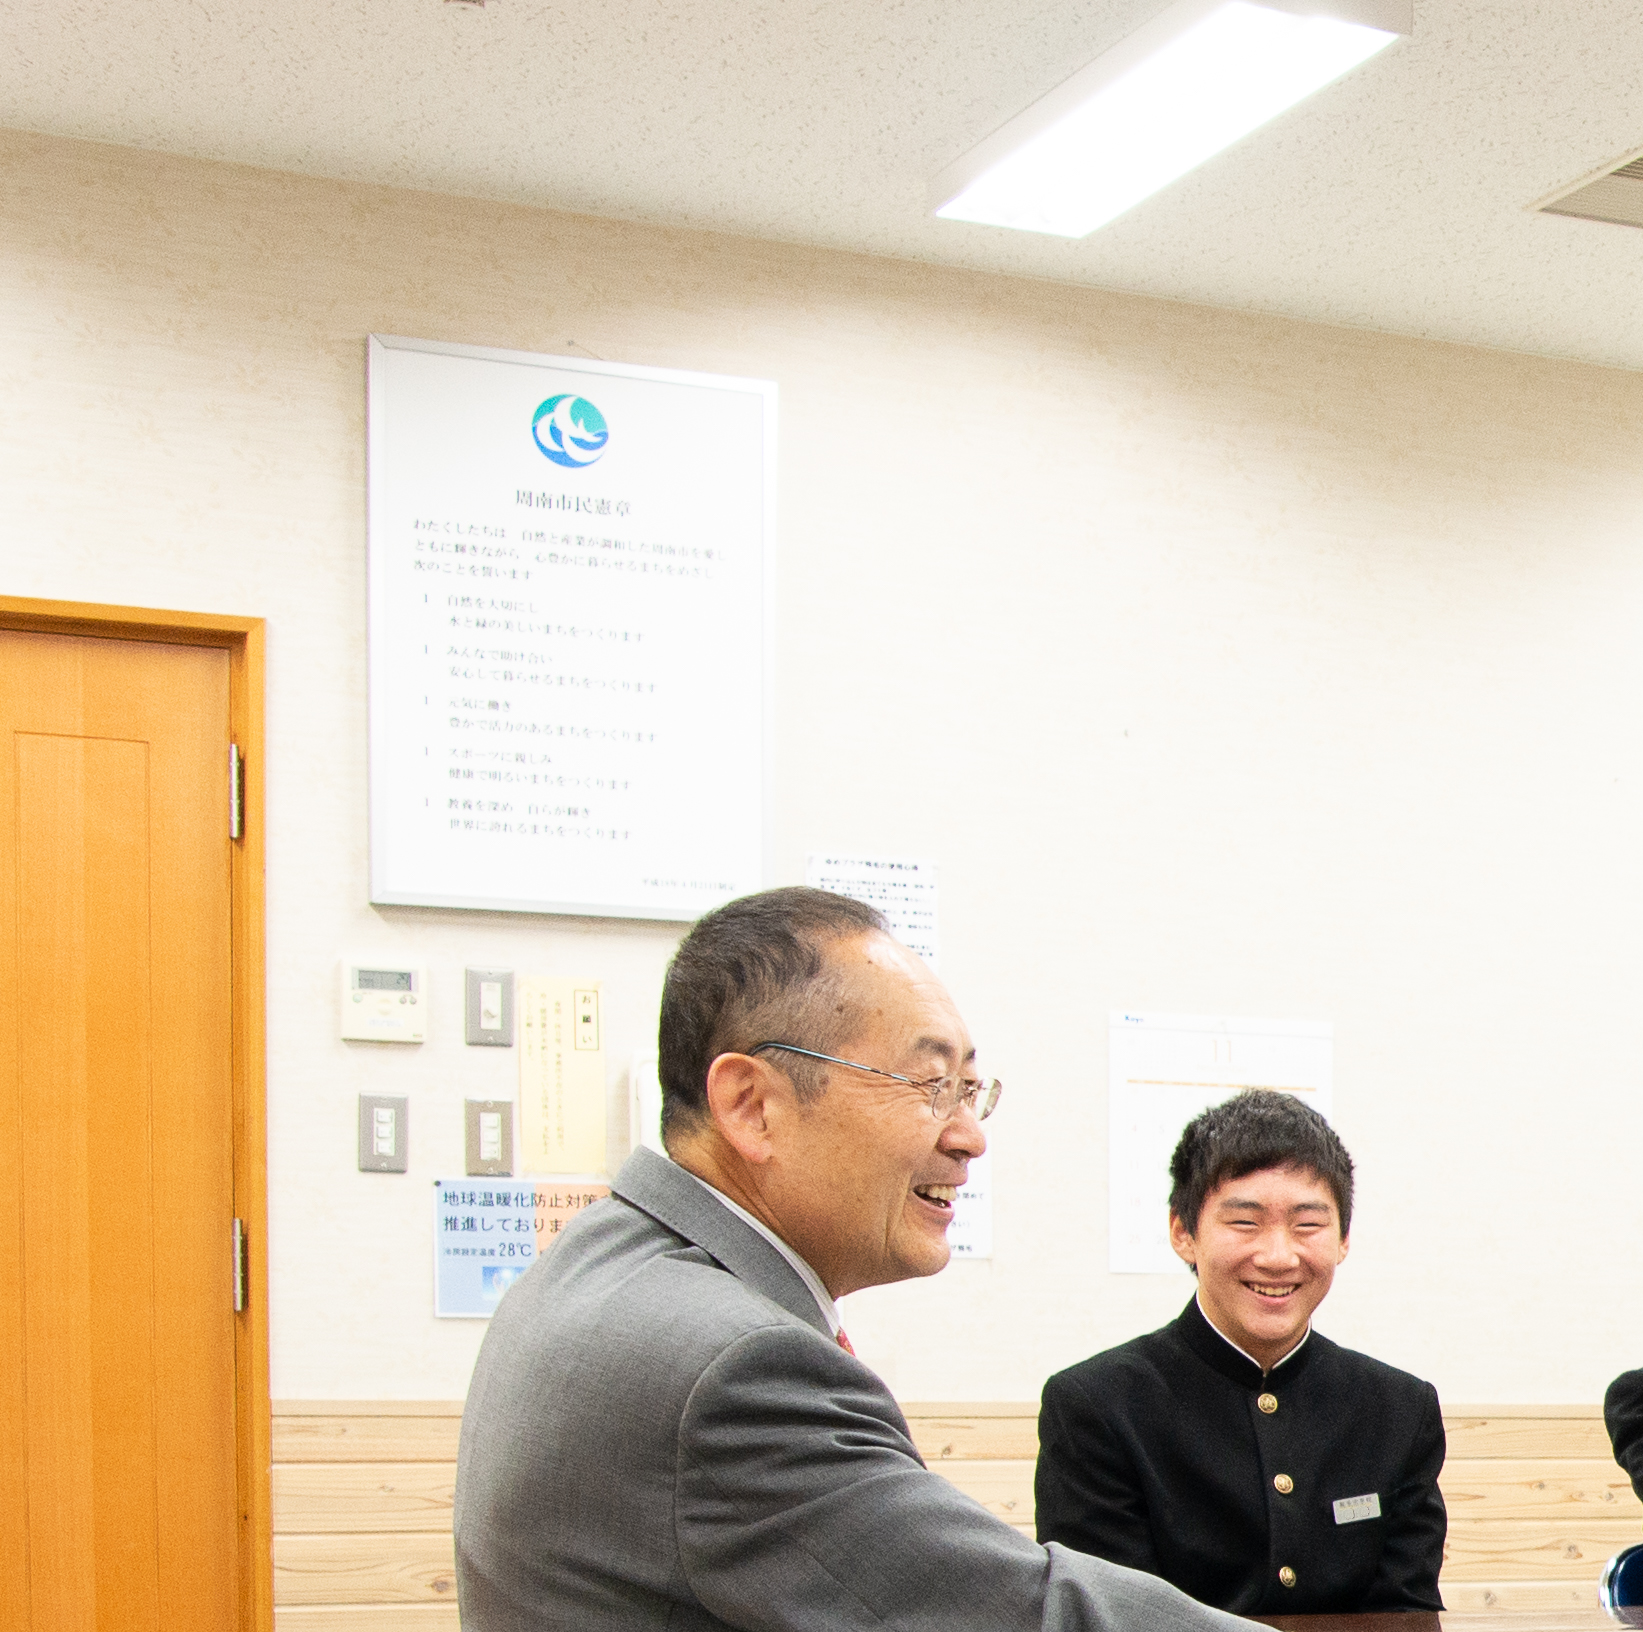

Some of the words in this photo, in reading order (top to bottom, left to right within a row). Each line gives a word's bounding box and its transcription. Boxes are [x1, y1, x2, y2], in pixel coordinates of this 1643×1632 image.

[515, 488, 631, 517] 周南市民憲章
[413, 518, 506, 539] わたくしたちは
[447, 594, 539, 615] 自然を大切にし
[449, 614, 645, 643] 水と緑の美しいまちをつくります
[446, 645, 553, 665] みんなで助け合い
[449, 665, 657, 693] 安心して暮らせるまちをつくります
[448, 716, 657, 743] 豊かで活力のあるまちをつくります
[448, 747, 553, 765] スポーツに親しみ
[448, 767, 631, 791] 健康で明るいまちをつくります
[443, 1190, 608, 1209] 地球温暖化防止対策
[443, 1215, 569, 1234] 推進しておりま
